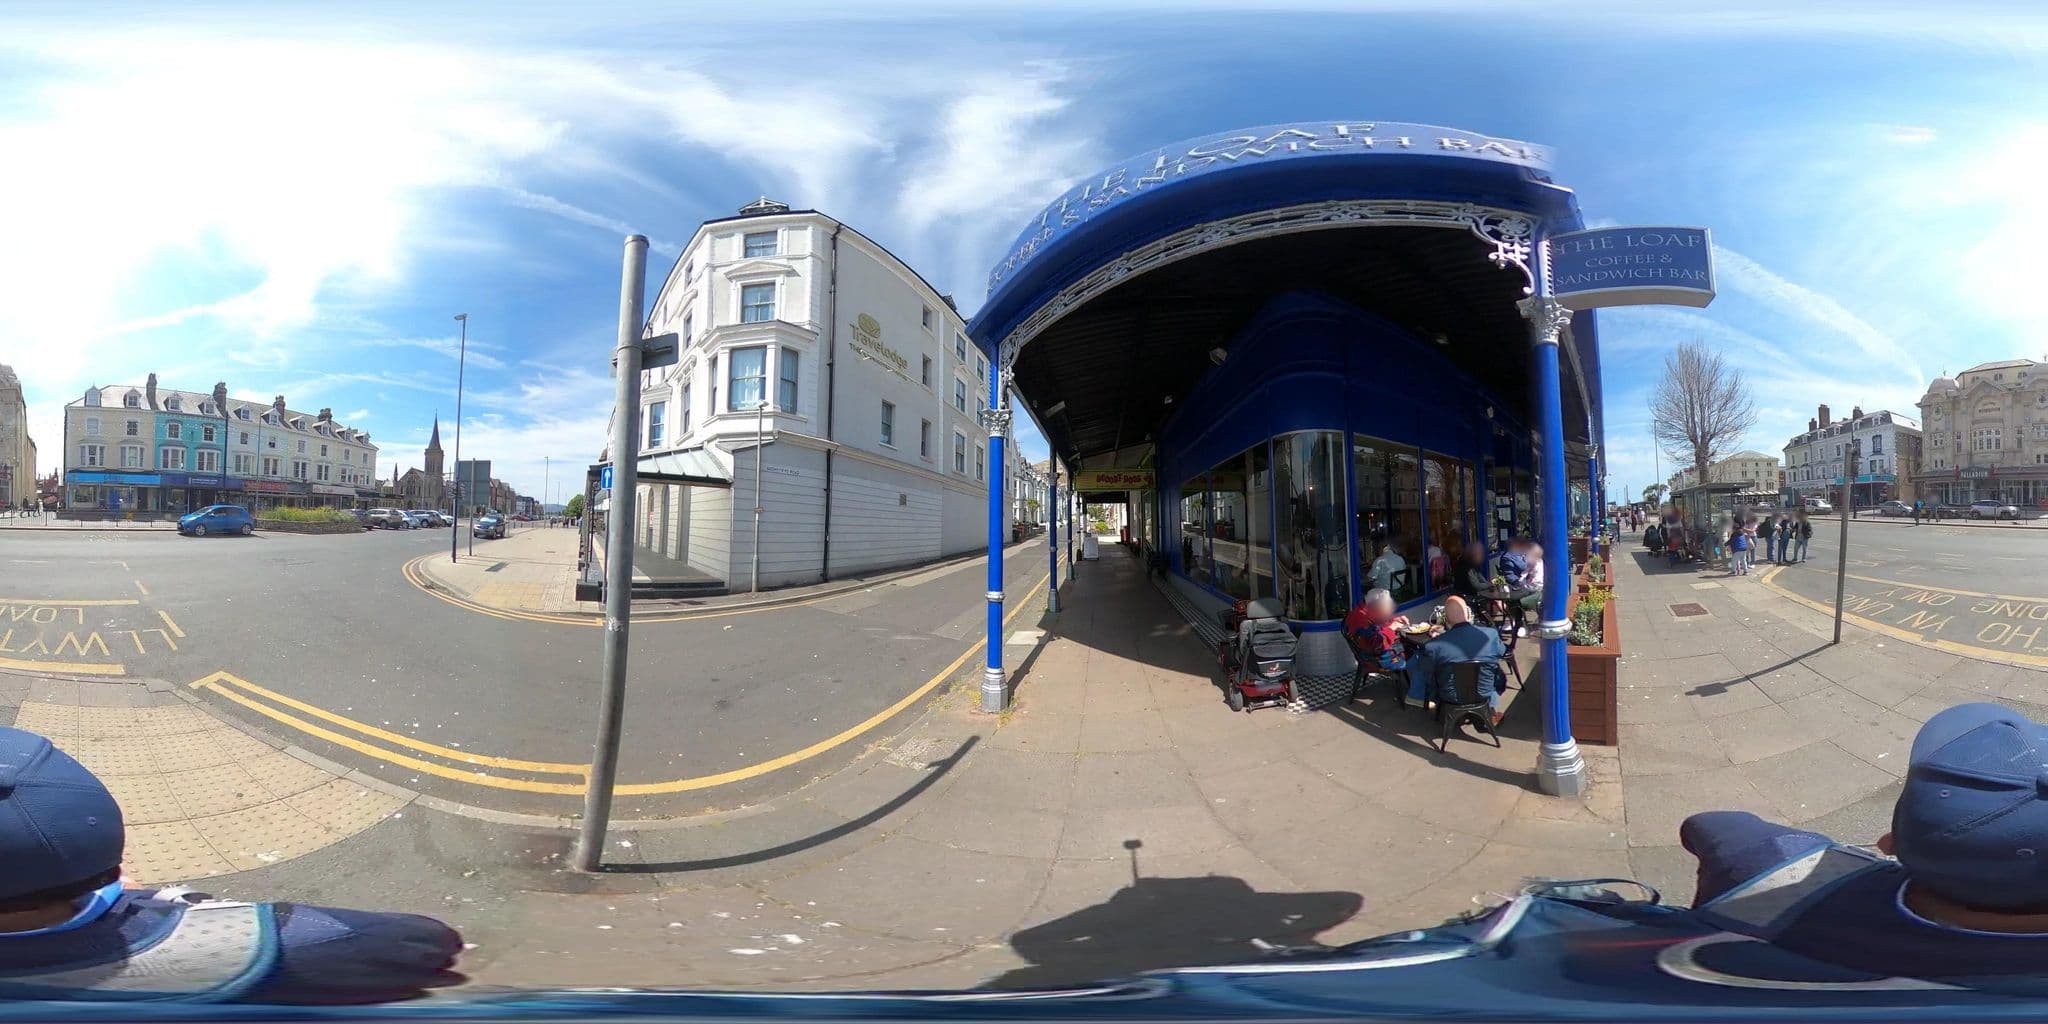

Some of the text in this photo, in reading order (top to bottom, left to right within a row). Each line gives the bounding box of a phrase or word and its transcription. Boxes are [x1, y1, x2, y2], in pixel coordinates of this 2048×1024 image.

[1033, 122, 1376, 226] THE LOAF
[1088, 136, 1414, 212] SANDWICH
[1437, 137, 1550, 162] BAR
[1553, 234, 1702, 254] THE LOAF
[1585, 254, 1673, 267] COFFEE &
[1555, 268, 1706, 286] SANDWICH BAR
[849, 323, 908, 370] Travelodge
[1875, 586, 1956, 606] ONLY
[1896, 610, 1956, 633] YN
